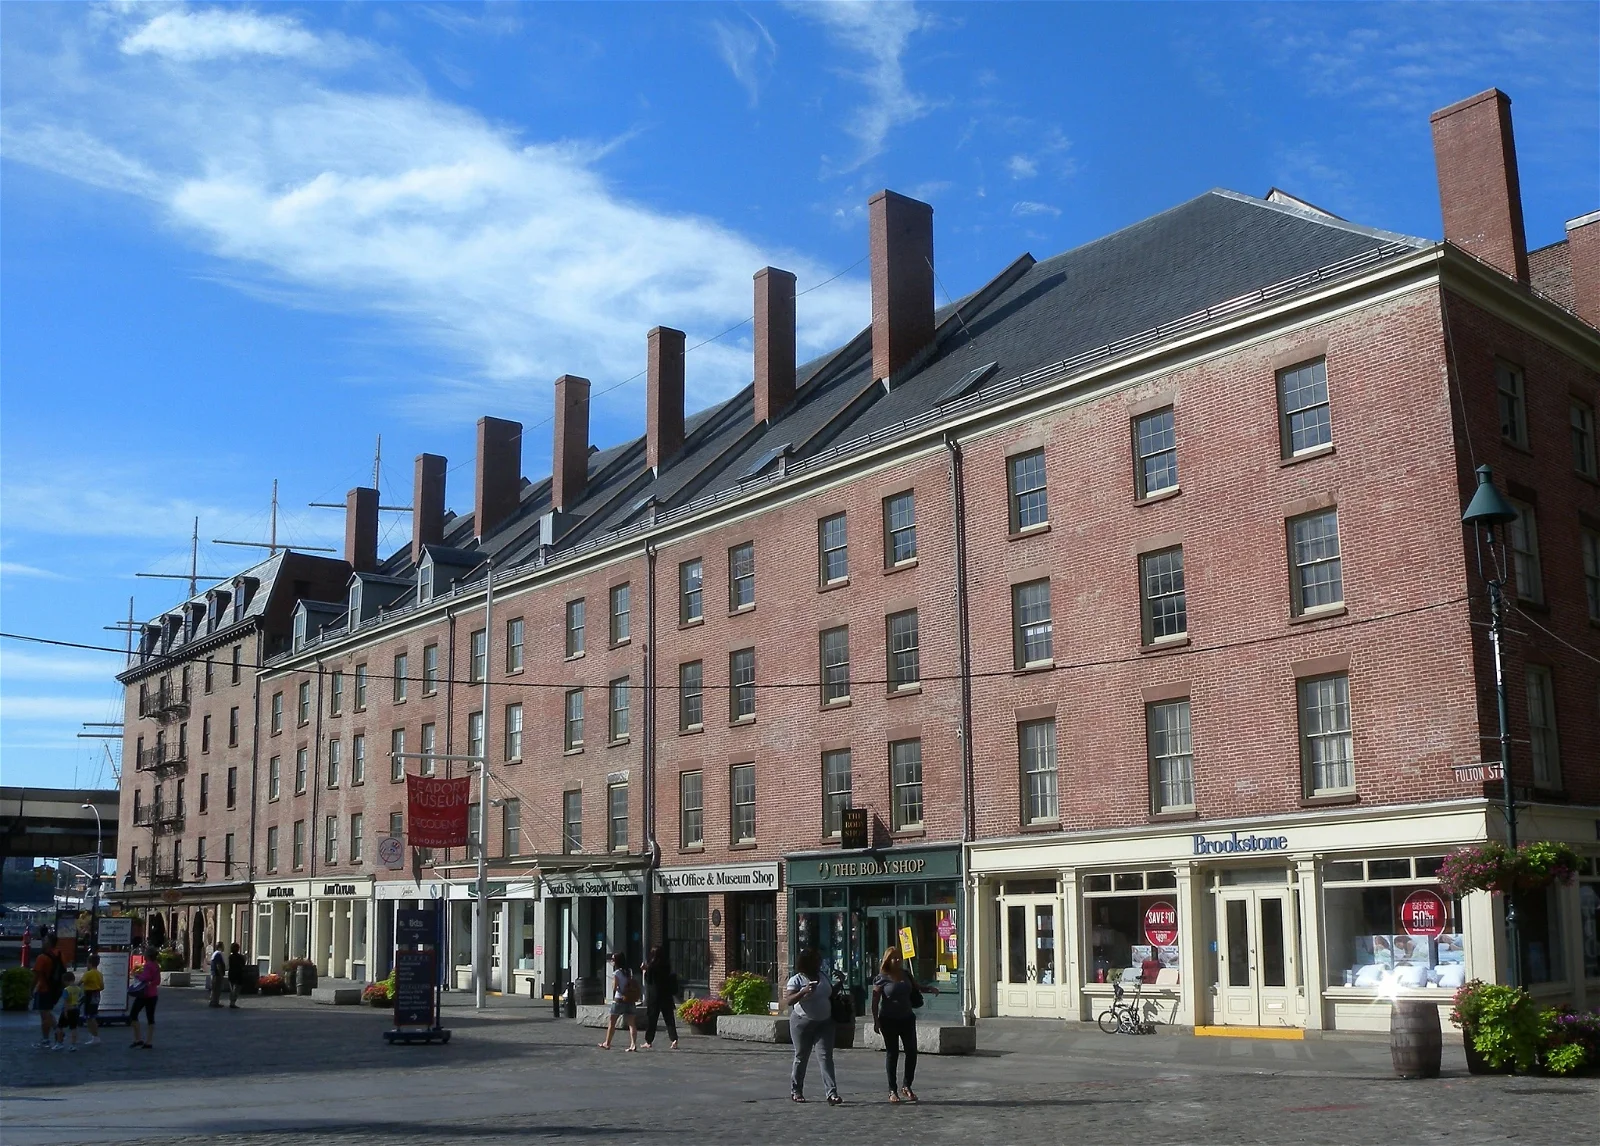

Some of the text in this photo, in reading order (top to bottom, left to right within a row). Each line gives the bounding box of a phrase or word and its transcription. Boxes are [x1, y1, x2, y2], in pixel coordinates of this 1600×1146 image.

[1455, 765, 1499, 782] FULTON ST
[411, 791, 467, 808] MUSEUM
[1193, 831, 1288, 855] Brookstone
[833, 862, 857, 876] THE
[892, 858, 925, 873] SHOP
[658, 870, 775, 887] Ticket Office & Museum Shop
[566, 882, 585, 893] Street
[586, 882, 610, 895] Seaport
[612, 880, 638, 892] Museum
[1148, 911, 1175, 924] SAVE $10
